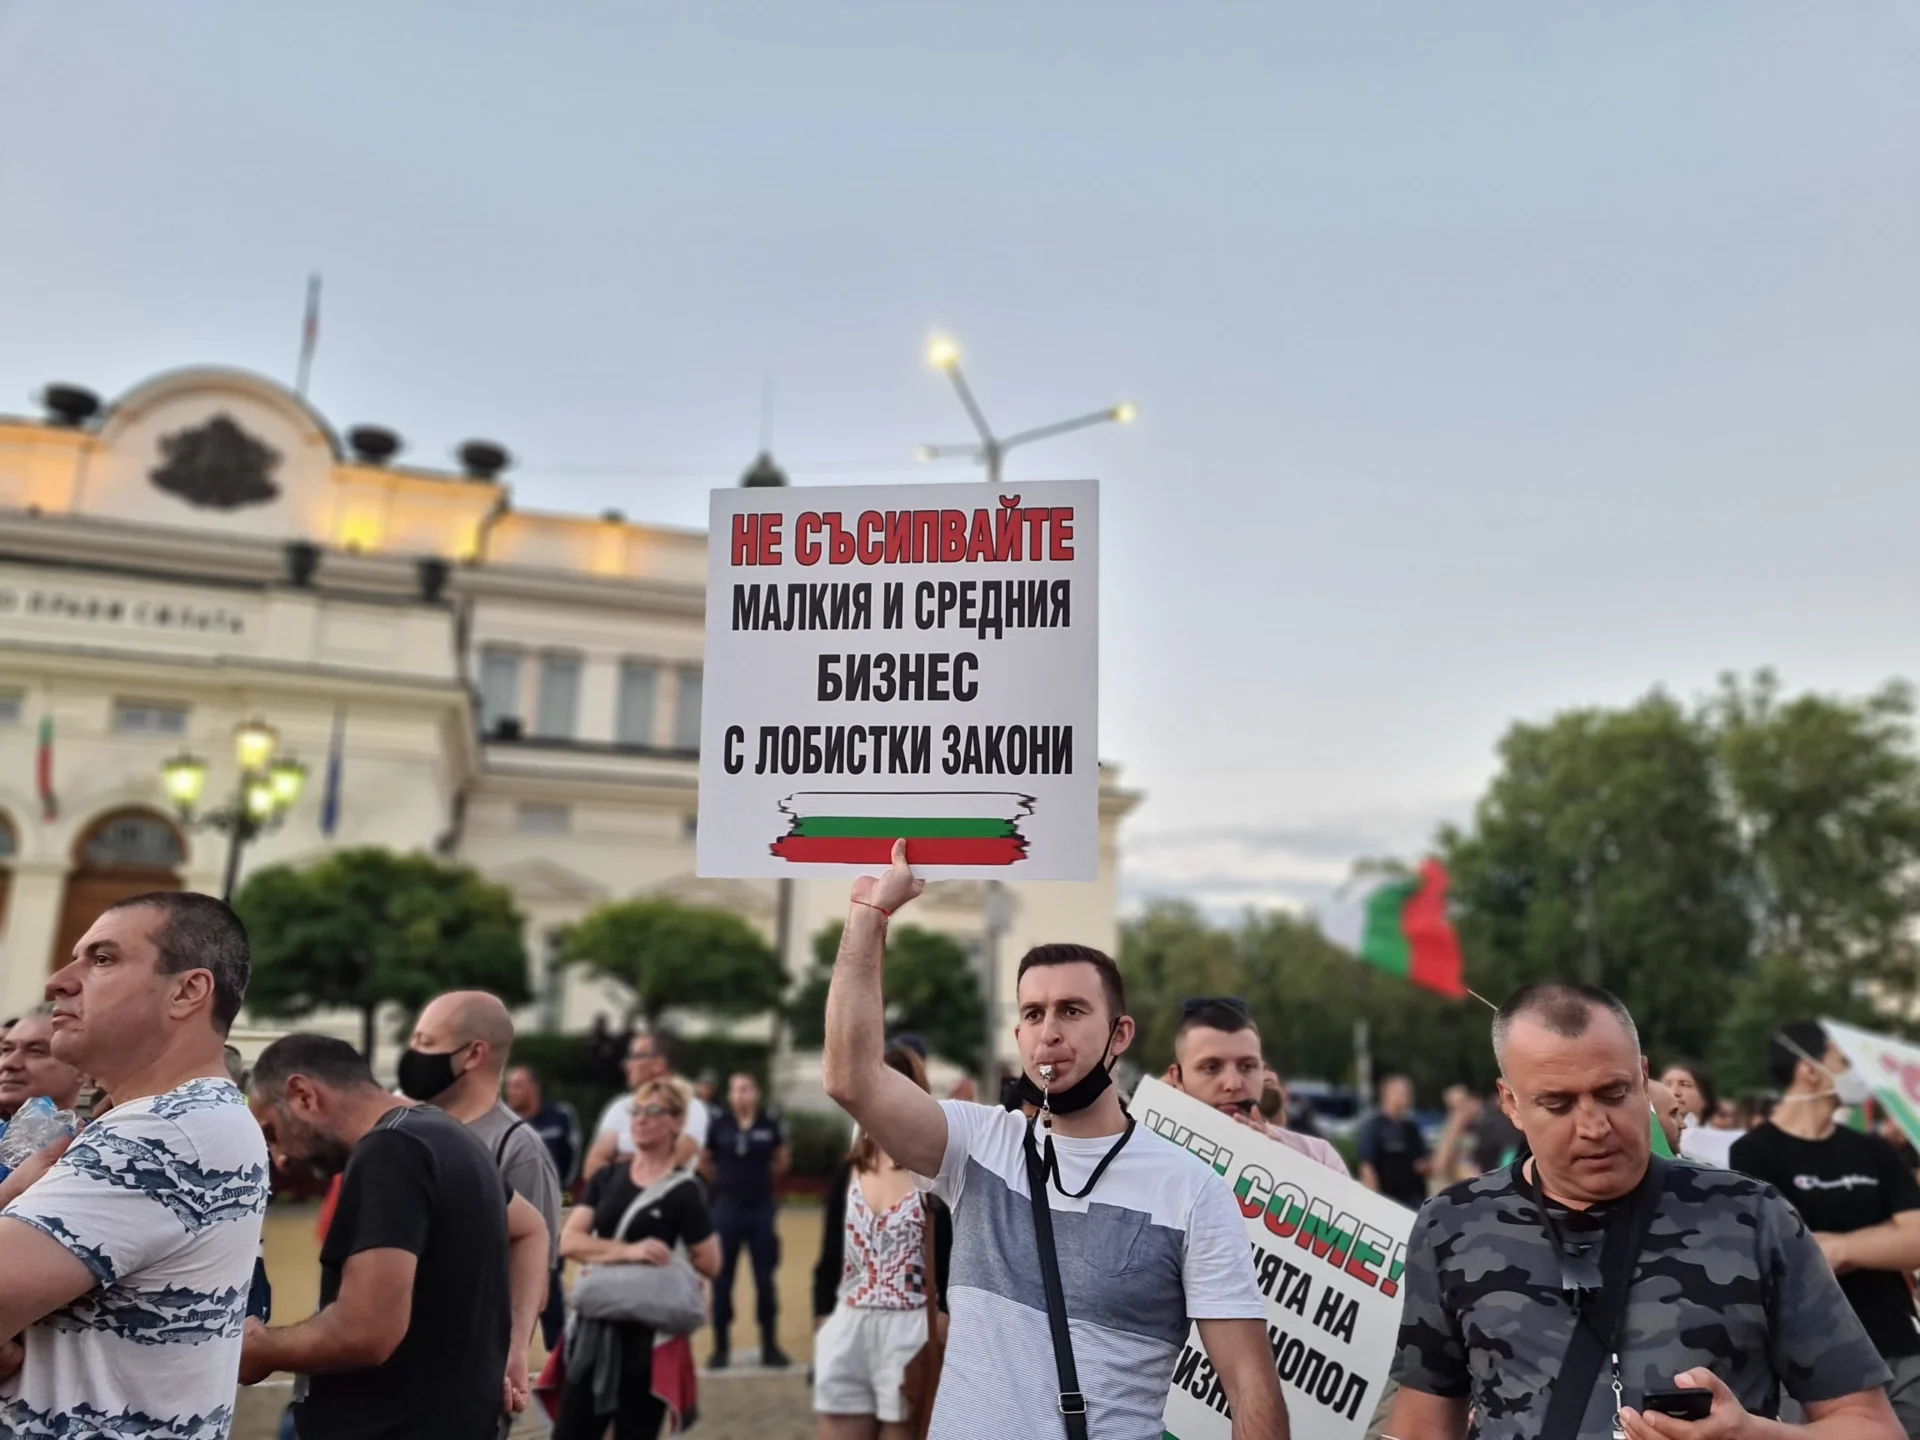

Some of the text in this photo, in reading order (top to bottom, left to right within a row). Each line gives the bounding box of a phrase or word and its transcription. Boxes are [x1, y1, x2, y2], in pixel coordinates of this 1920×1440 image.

[731, 495, 1074, 566] НЕ СЪСИПВАЙТЕ
[732, 580, 1071, 640] МАЛКИЯ И СРЕДНИЯ
[817, 652, 979, 702] БИЗНЕС
[724, 725, 1073, 775] С ЛОБИСТКИ ЗАКОНИ
[1312, 1286, 1360, 1345] НА
[1172, 1345, 1232, 1420] ИЗН
